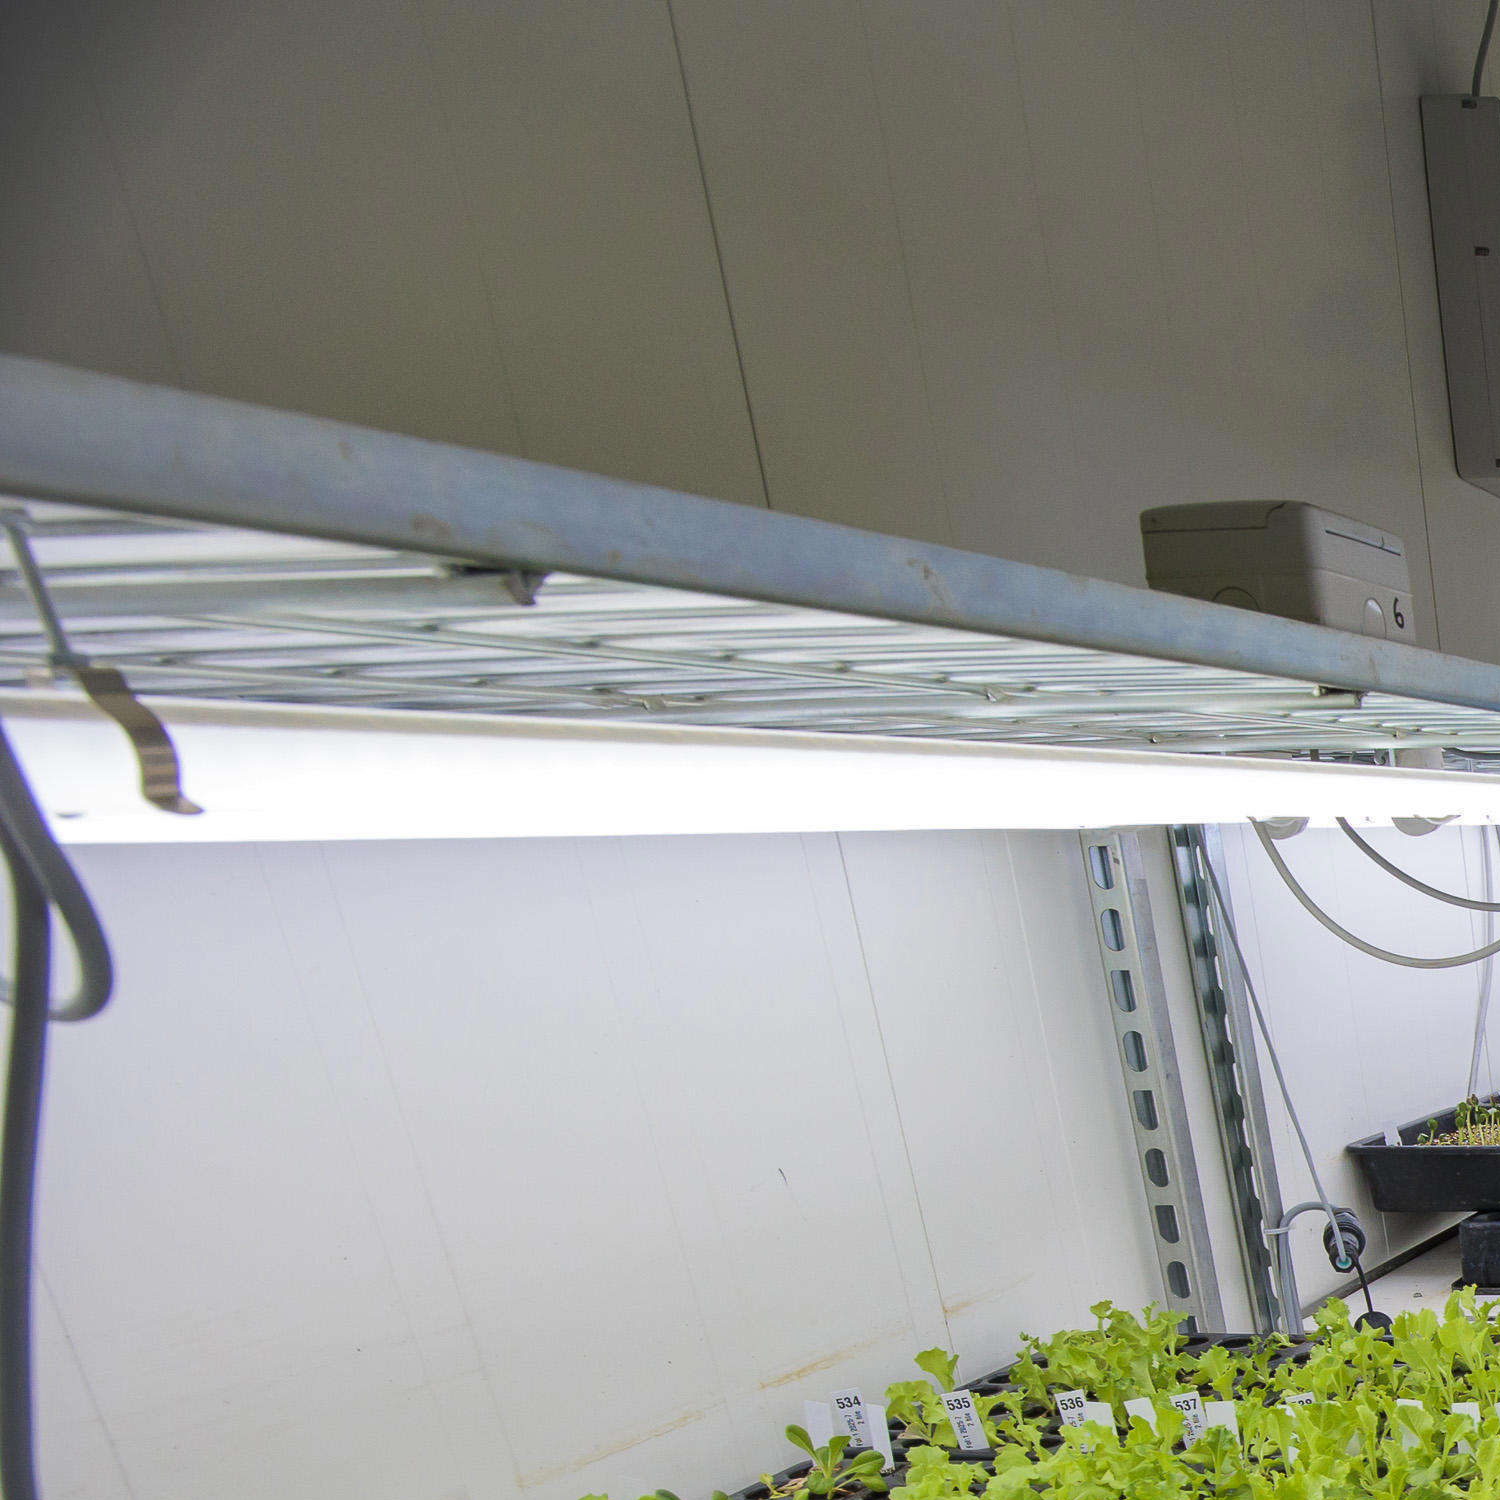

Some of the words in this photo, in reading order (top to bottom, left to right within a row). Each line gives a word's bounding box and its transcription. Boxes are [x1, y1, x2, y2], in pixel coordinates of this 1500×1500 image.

[1393, 597, 1404, 629] 6
[836, 1396, 862, 1409] 534
[946, 1397, 971, 1411] 535
[1060, 1397, 1084, 1410] 536
[1175, 1399, 1196, 1411] 537
